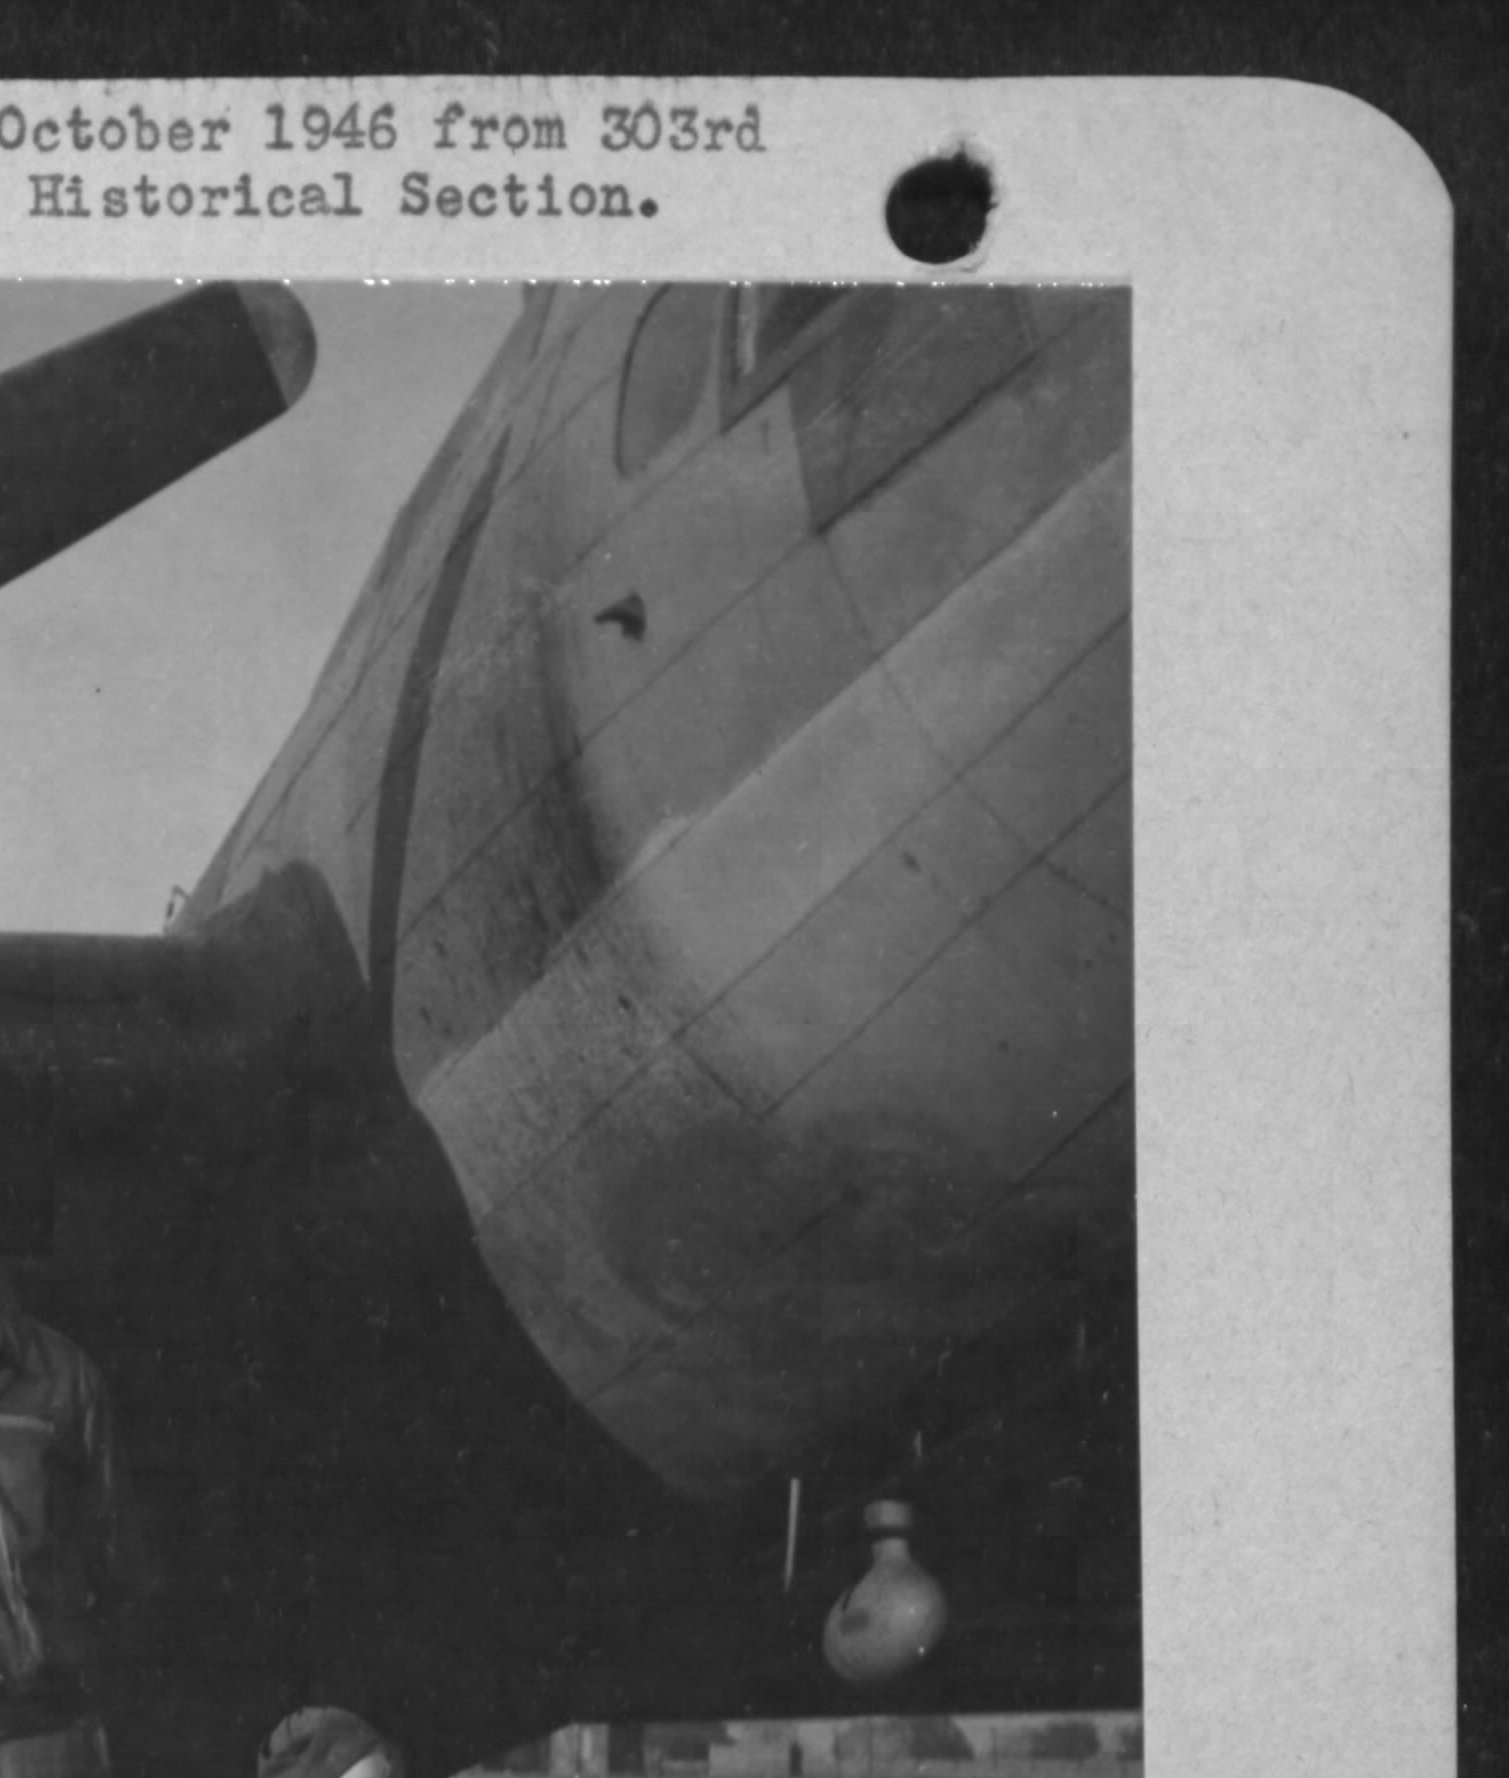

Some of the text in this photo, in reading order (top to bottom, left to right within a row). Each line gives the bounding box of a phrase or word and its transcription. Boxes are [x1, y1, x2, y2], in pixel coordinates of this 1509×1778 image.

[264, 100, 398, 152] 1946
[433, 99, 568, 154] from
[599, 98, 767, 153] 303rd
[28, 171, 364, 218] Historical
[398, 170, 660, 219] Section.
